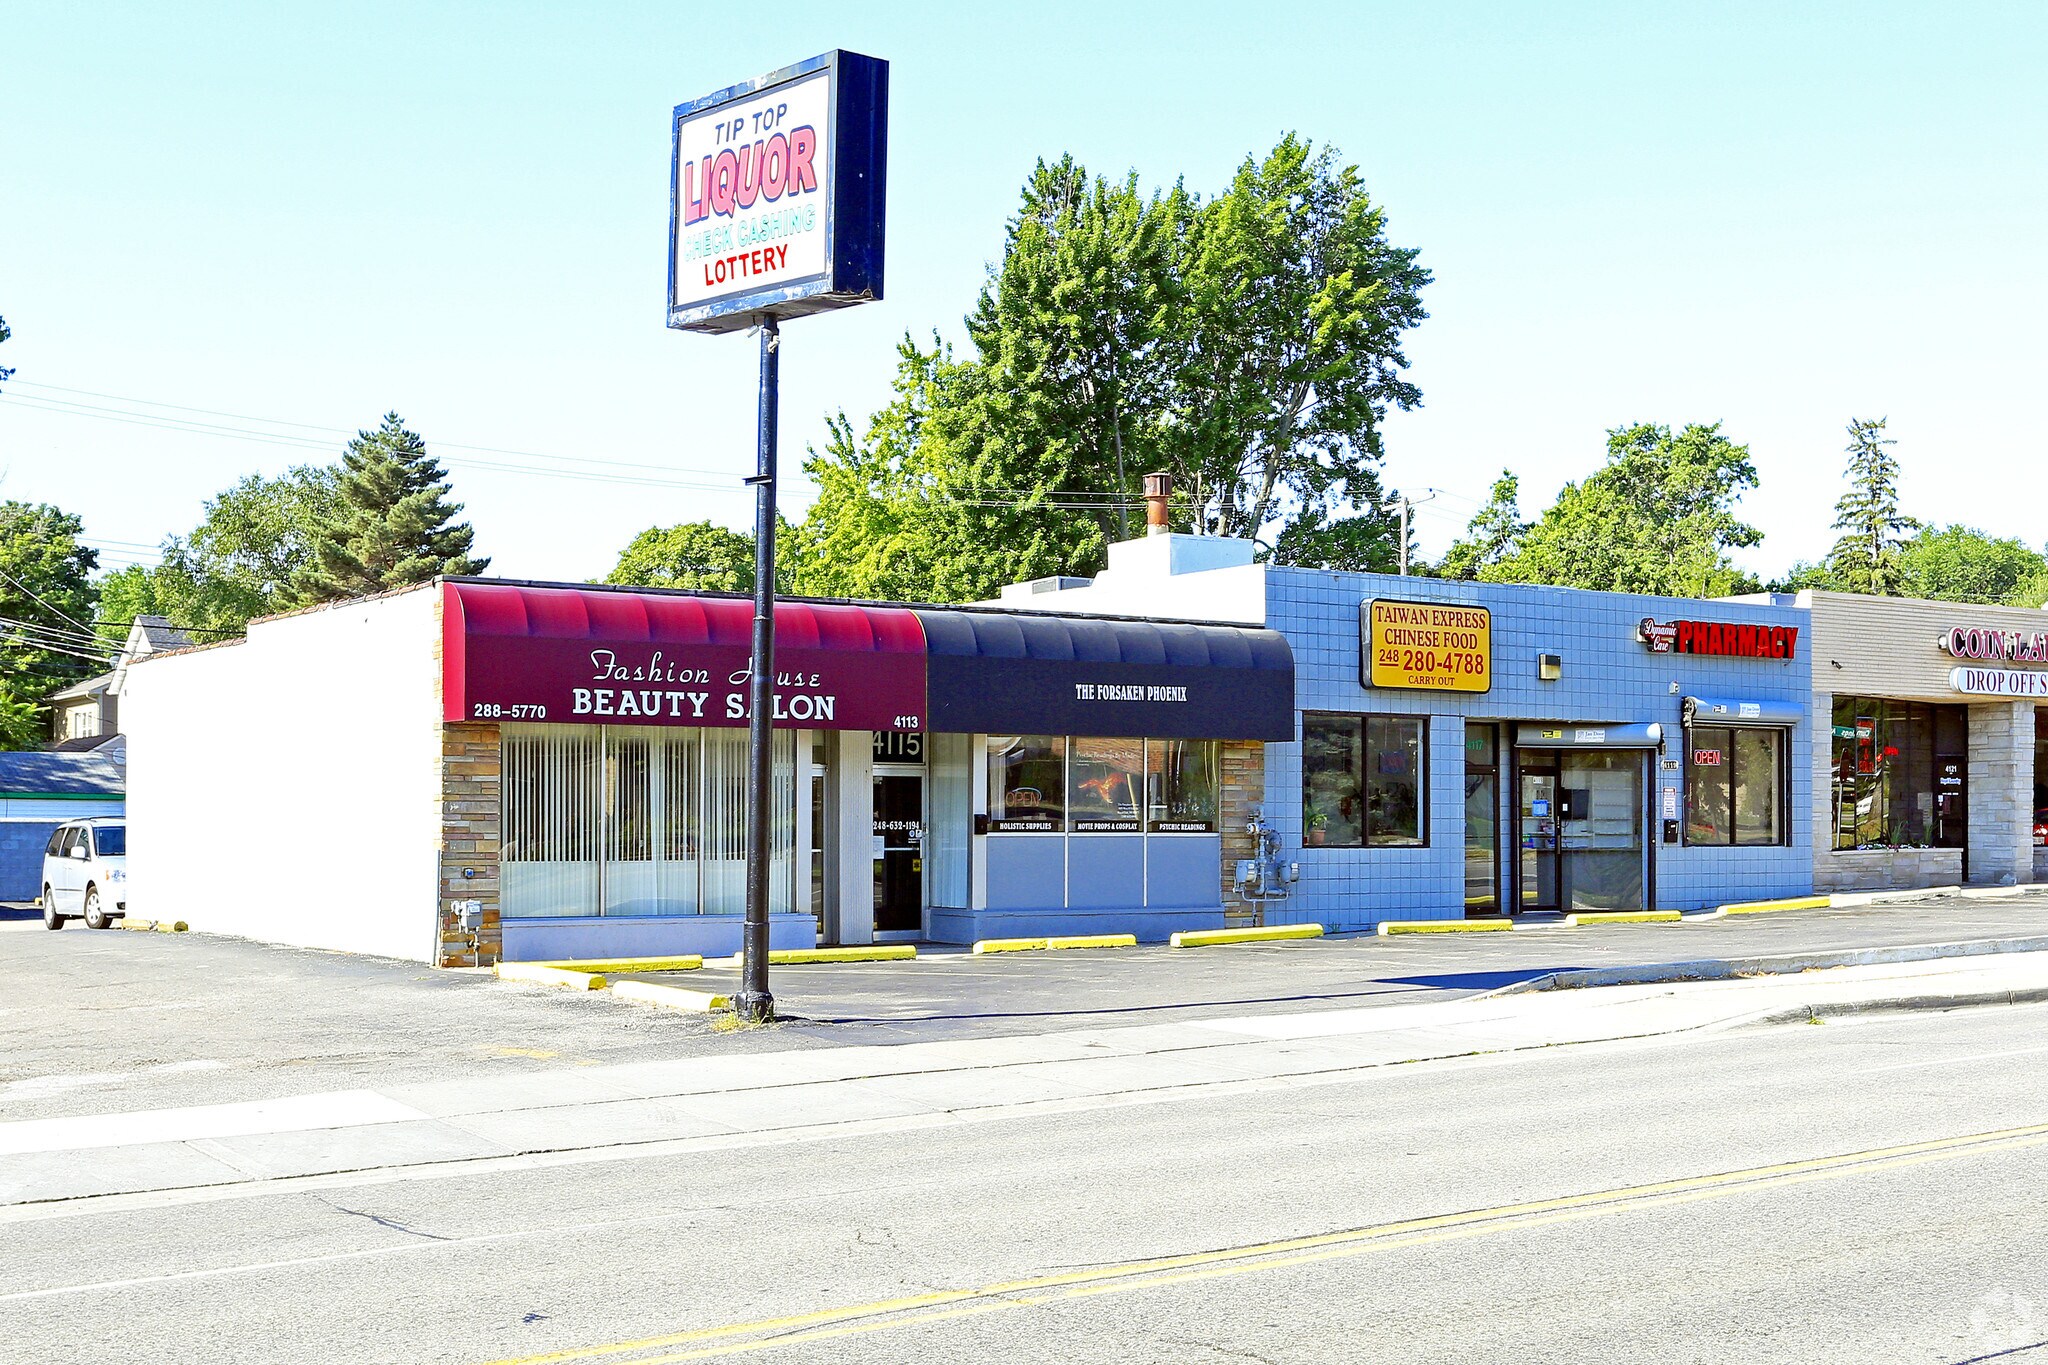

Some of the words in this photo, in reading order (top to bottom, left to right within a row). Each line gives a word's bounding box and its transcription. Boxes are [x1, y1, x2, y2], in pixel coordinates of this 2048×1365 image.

[715, 117, 744, 145] TIP
[752, 103, 787, 135] TOP
[684, 124, 817, 226] LIQUOR
[737, 204, 817, 248] CASHING
[704, 244, 789, 286] LOTTERY
[1375, 606, 1428, 625] TAIWAN
[1432, 610, 1486, 630] EXPRESS
[1644, 619, 1677, 640] Dynamic
[1384, 628, 1440, 648] CHINESE
[1443, 632, 1478, 650] FOOD
[1653, 637, 1669, 652] Care
[1678, 620, 1799, 659] PHARMACY
[1949, 627, 2007, 659] COIN
[2014, 632, 2048, 662] LA
[590, 650, 710, 684] Fashion
[728, 657, 821, 687] Huse
[1379, 649, 1399, 662] 248
[1403, 650, 1484, 675] 280-4788
[1408, 675, 1436, 685] CARRY
[1438, 676, 1455, 686] OUT
[1966, 670, 2005, 692] DROP
[2009, 672, 2036, 694] OFF
[1075, 683, 1095, 700] THE
[1097, 685, 1145, 701] FORSAKEN
[1147, 686, 1187, 702] PHOENIX
[474, 703, 547, 719] 288-5770
[572, 688, 709, 718] BEAUTY
[726, 693, 836, 721] SLON
[893, 715, 919, 729] 4113
[873, 731, 920, 756] 4115
[1695, 751, 1720, 764] OPEN
[1005, 791, 1040, 807] OPEN
[873, 820, 920, 830] 248-632-1194
[1000, 822, 1025, 830] HOLISTIC
[1025, 822, 1052, 830] SUPPLIES
[1159, 823, 1181, 831] PSYCHIC
[1180, 823, 1206, 831] READINGS
